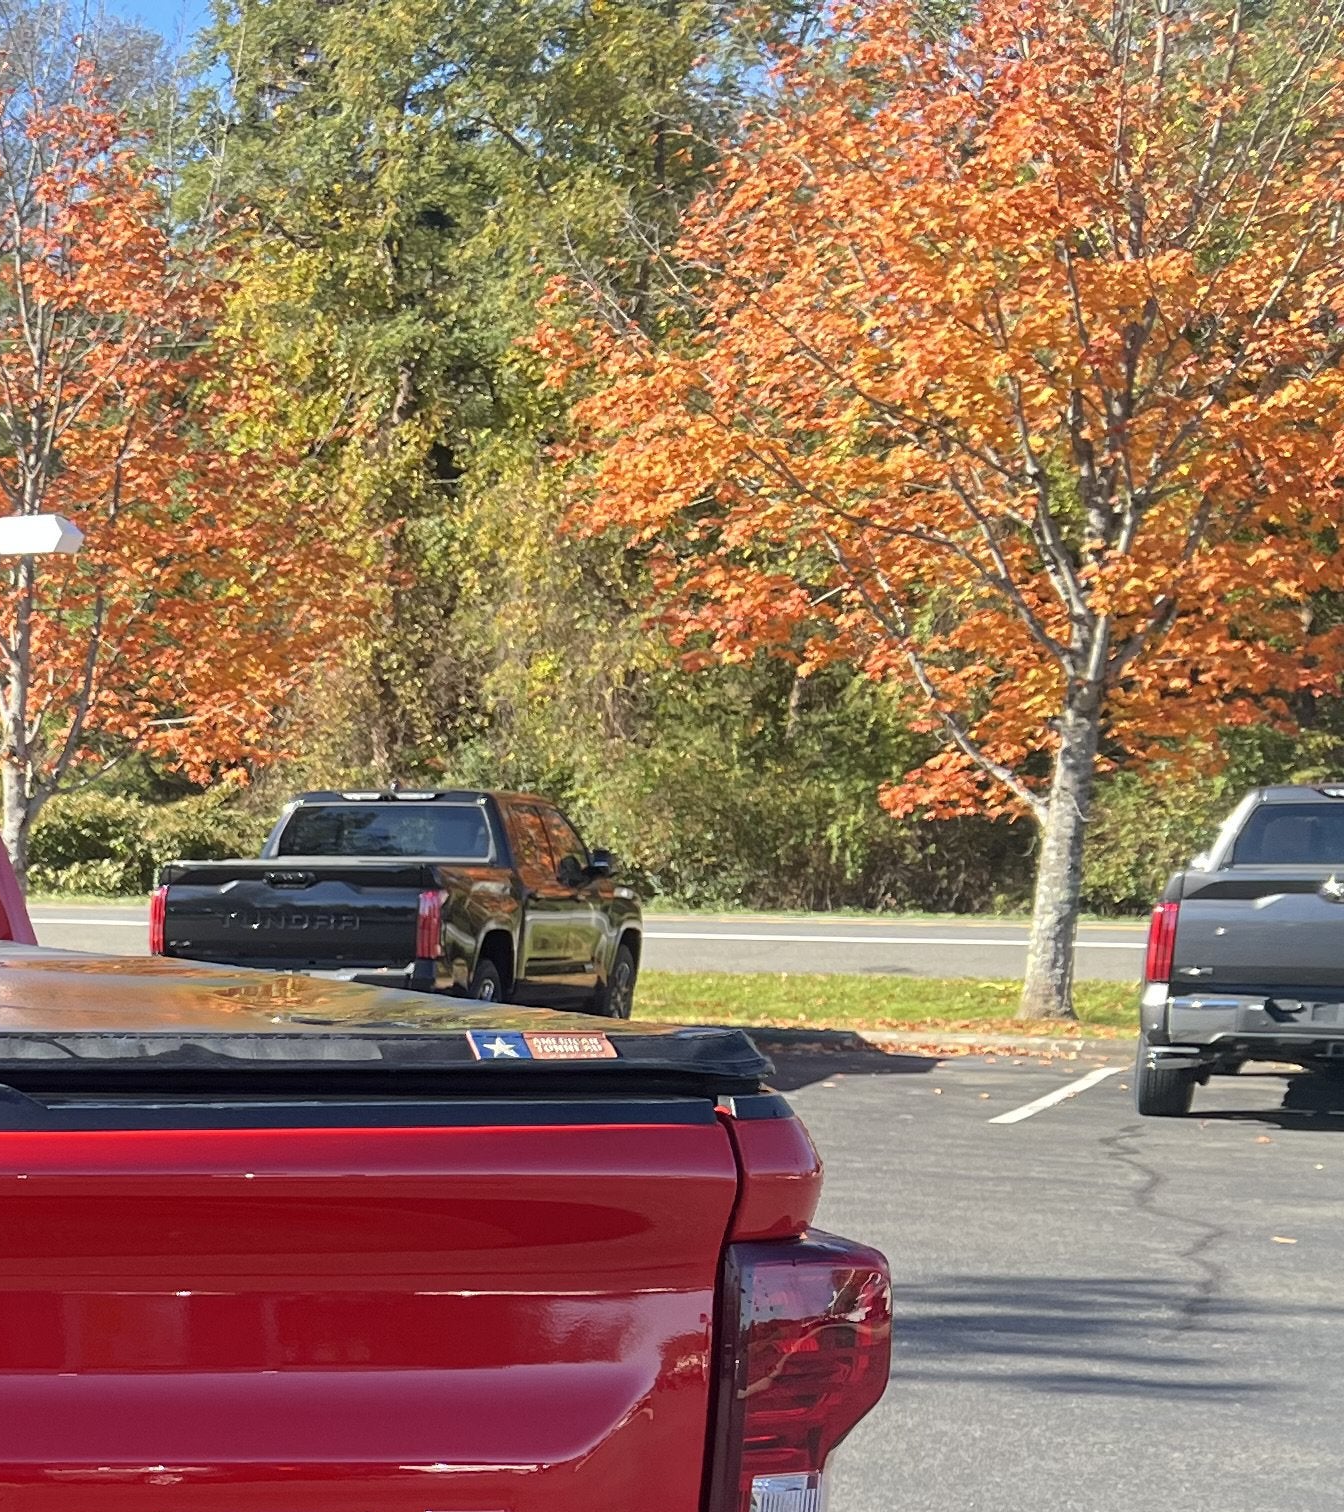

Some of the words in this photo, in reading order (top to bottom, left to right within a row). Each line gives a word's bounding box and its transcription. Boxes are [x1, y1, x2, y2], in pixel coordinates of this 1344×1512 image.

[219, 912, 361, 931] TUNDRA
[532, 1037, 599, 1046] AMERICAN
[536, 1044, 603, 1053] TONNEAU
